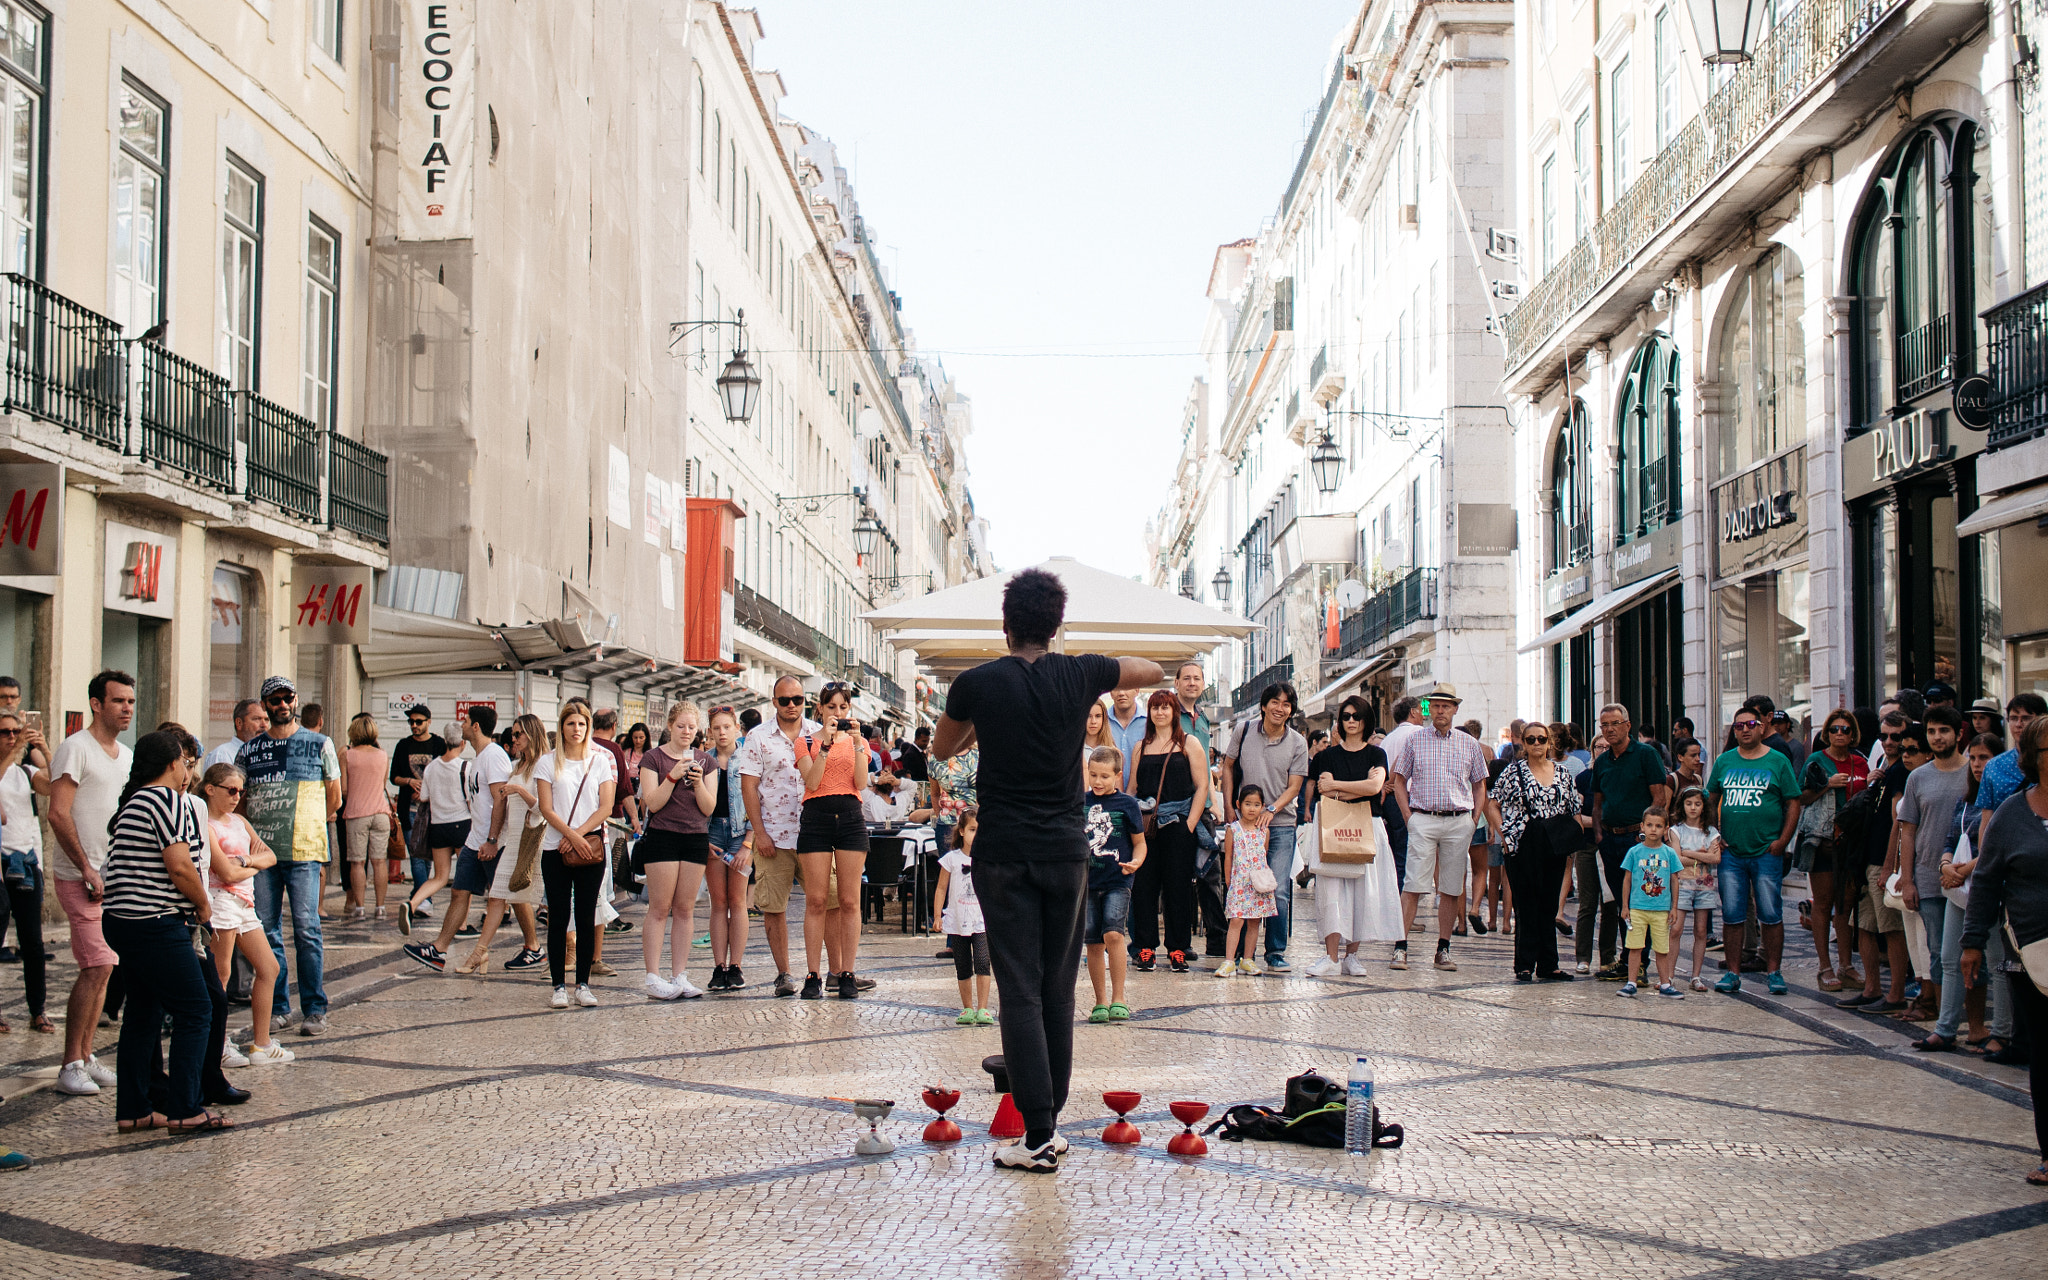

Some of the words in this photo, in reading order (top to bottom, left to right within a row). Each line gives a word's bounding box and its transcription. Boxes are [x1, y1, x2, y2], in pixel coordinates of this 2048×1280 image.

[421, 5, 453, 193] ECOCIAF
[1959, 397, 1988, 408] PAU
[1872, 407, 1937, 482] PAUL
[1724, 490, 1784, 543] PARFOIS
[297, 583, 363, 628] H&M
[1724, 789, 1764, 807] JONES
[1333, 828, 1363, 838] MUJI
